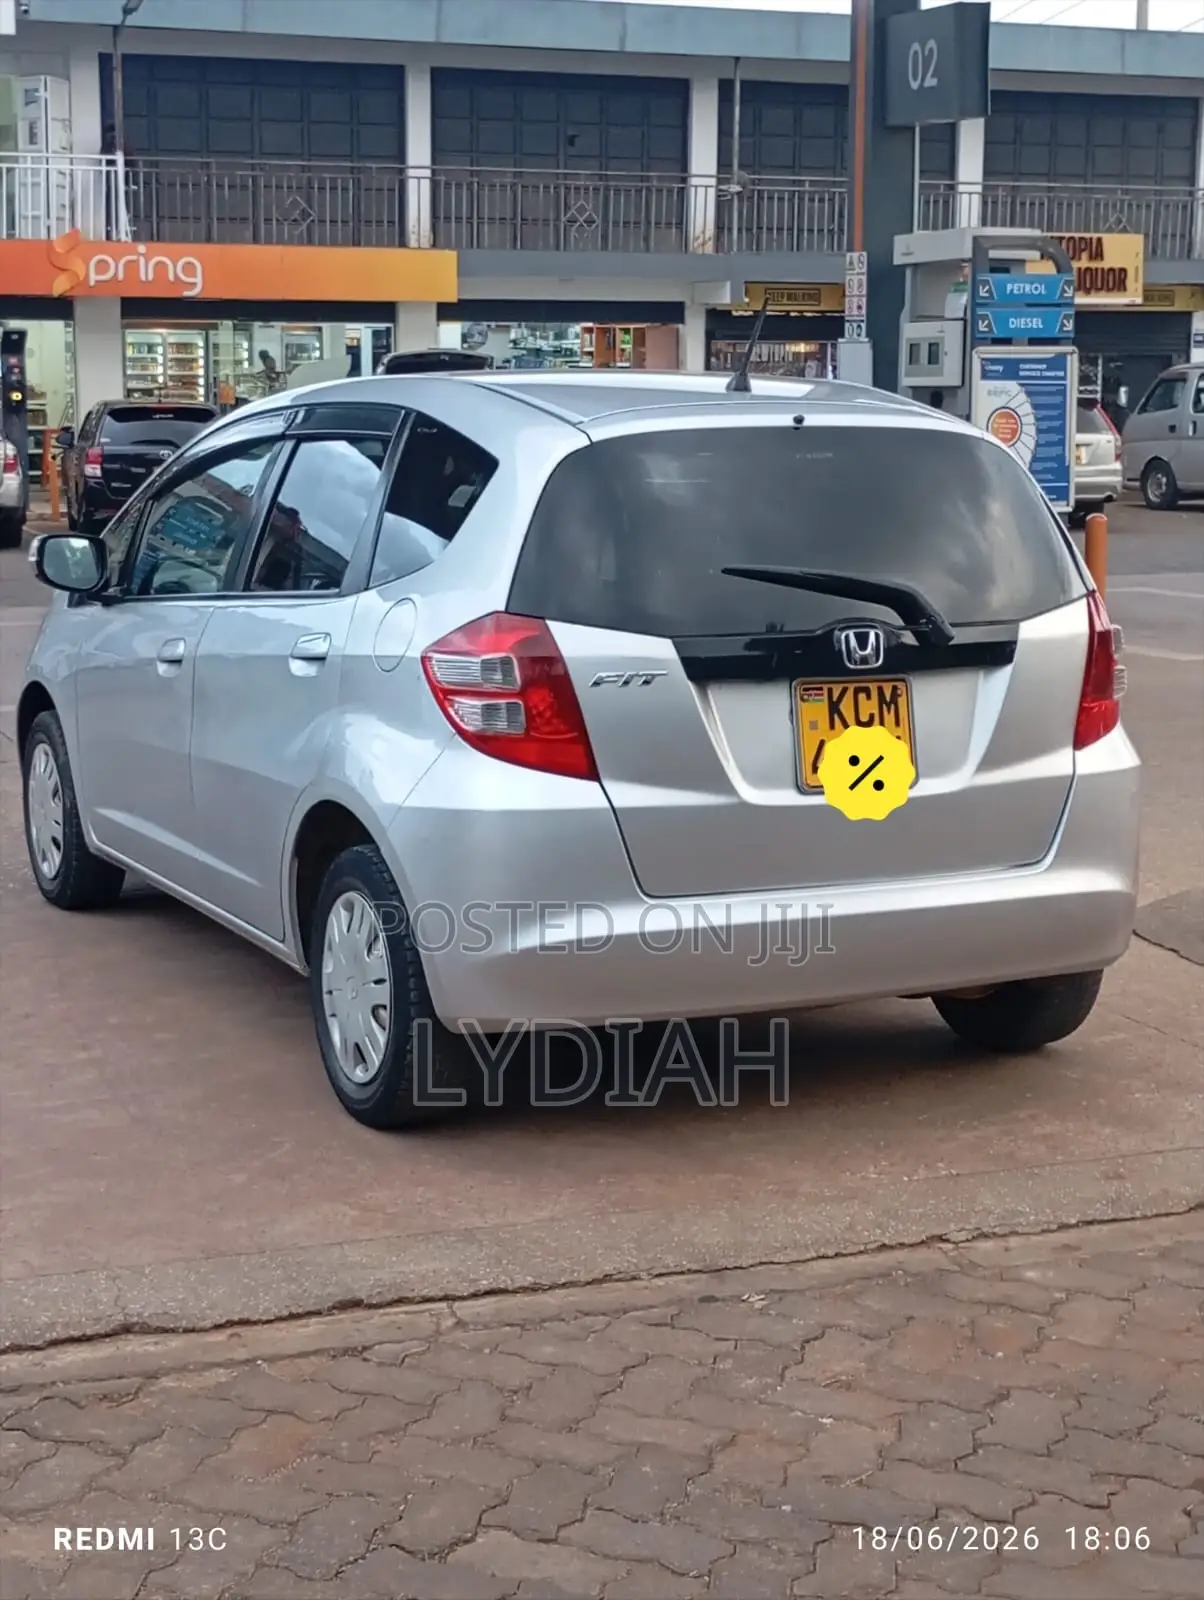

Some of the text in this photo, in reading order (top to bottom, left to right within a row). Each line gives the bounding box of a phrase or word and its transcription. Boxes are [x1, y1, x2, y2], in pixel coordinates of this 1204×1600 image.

[907, 38, 938, 90] 02
[1006, 283, 1047, 294] PETROL
[1008, 318, 1044, 328] DIESEL
[588, 670, 668, 688] FIT
[827, 685, 901, 730] KCM
